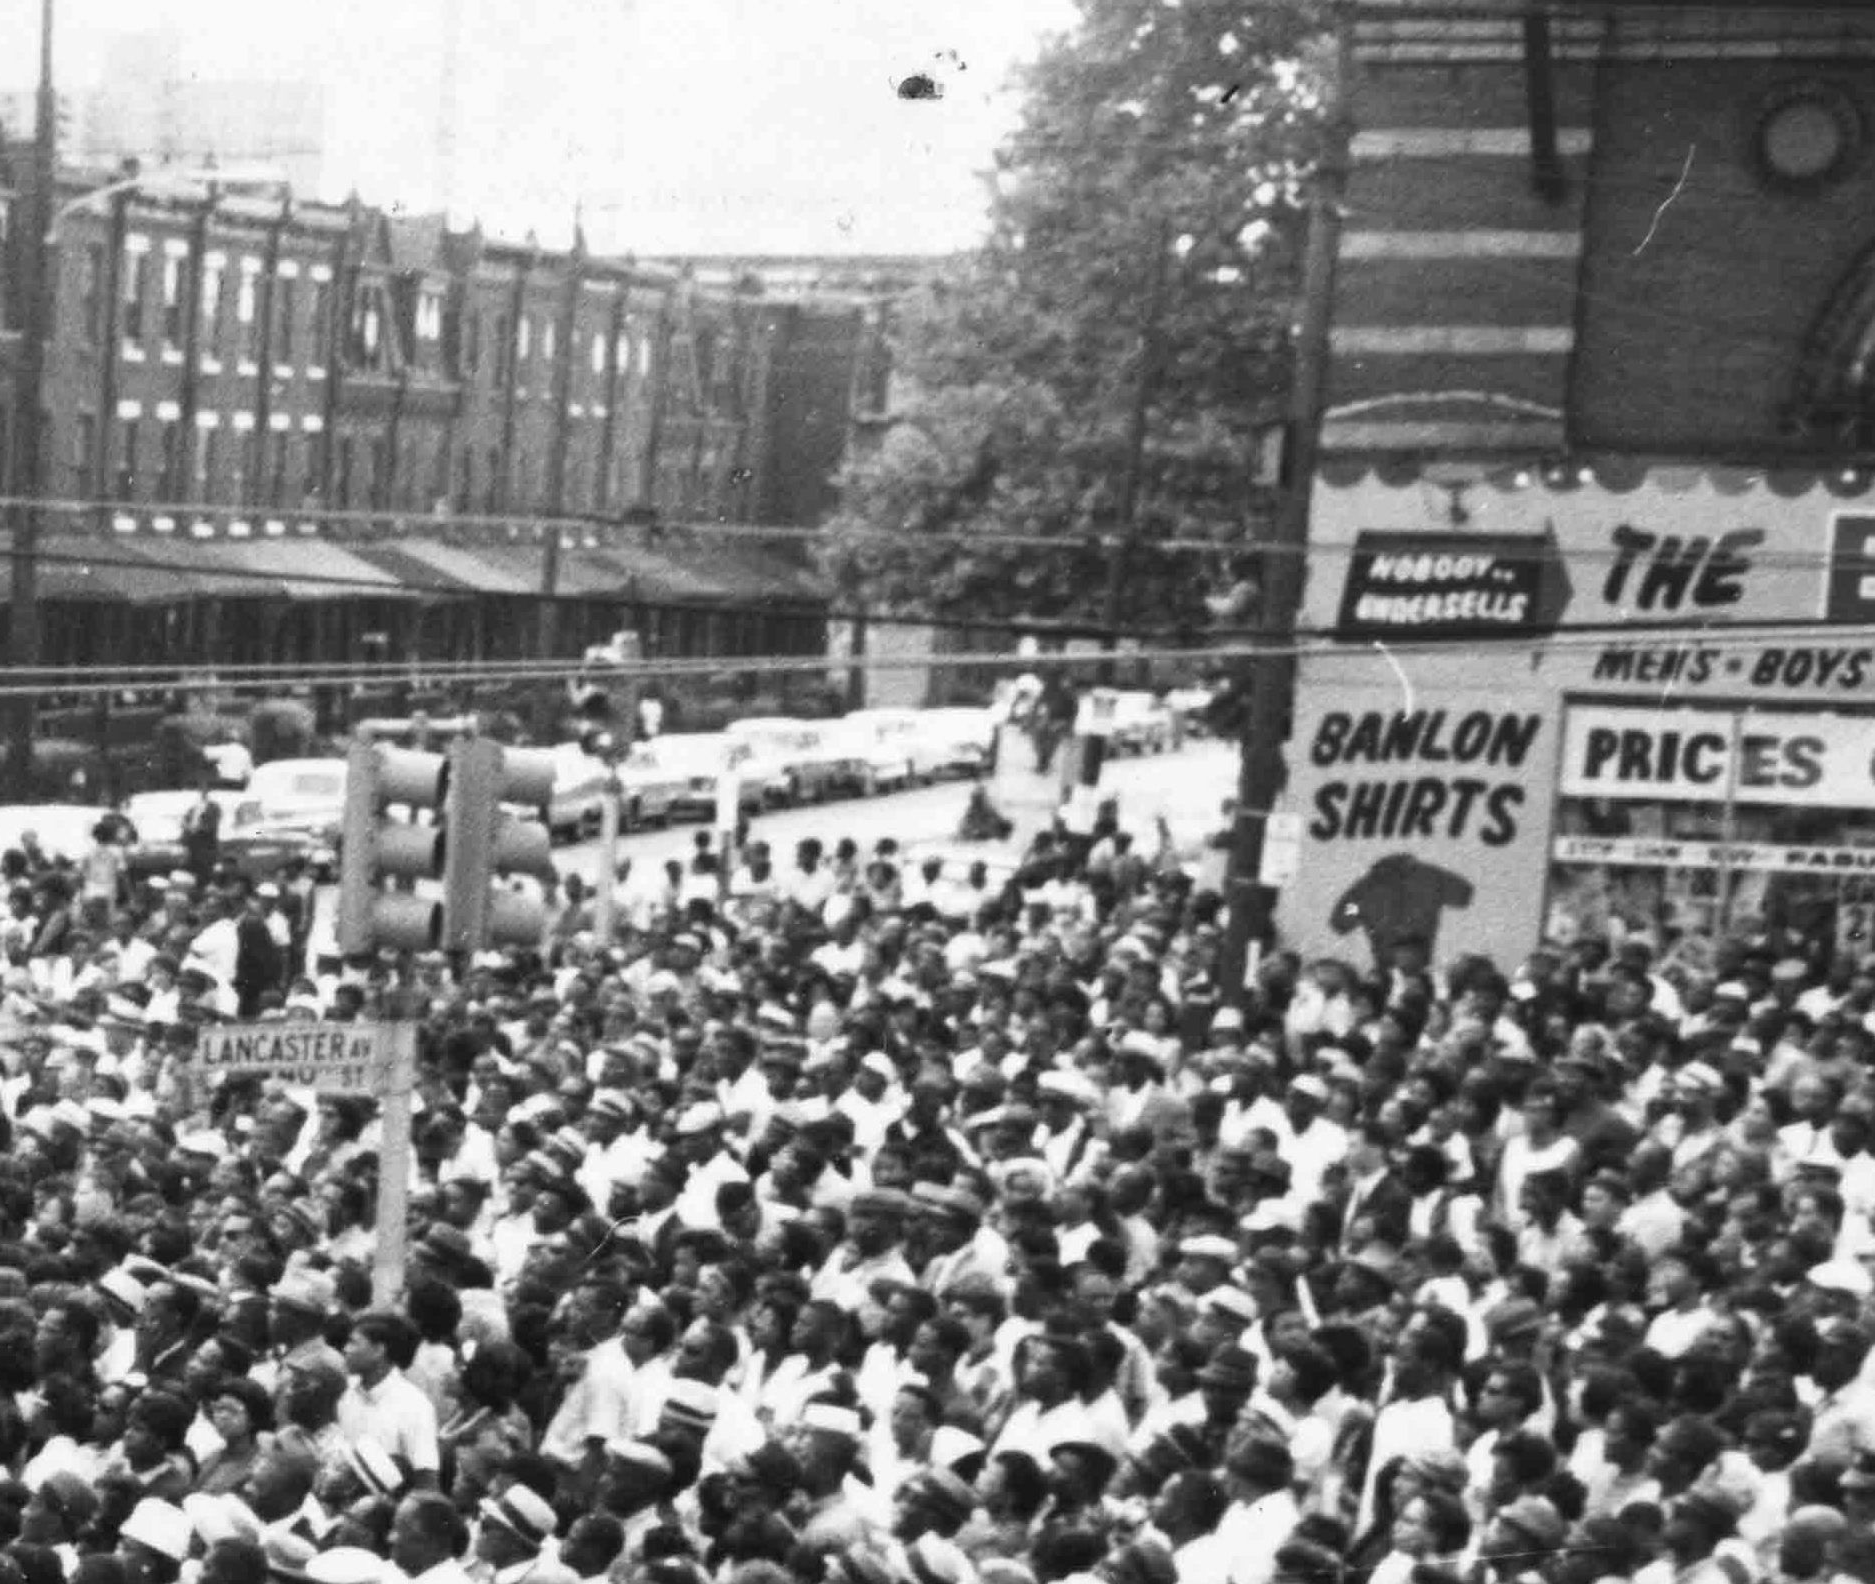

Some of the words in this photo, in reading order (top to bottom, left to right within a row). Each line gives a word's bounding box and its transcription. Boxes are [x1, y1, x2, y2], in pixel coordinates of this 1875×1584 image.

[1604, 524, 1765, 609] THE
[1752, 649, 1873, 689] BOYS
[1312, 711, 1541, 766] BANLON
[1583, 727, 1826, 788] PRICES
[1310, 778, 1525, 847] SHIRTS
[204, 1031, 344, 1064] LANCASTER
